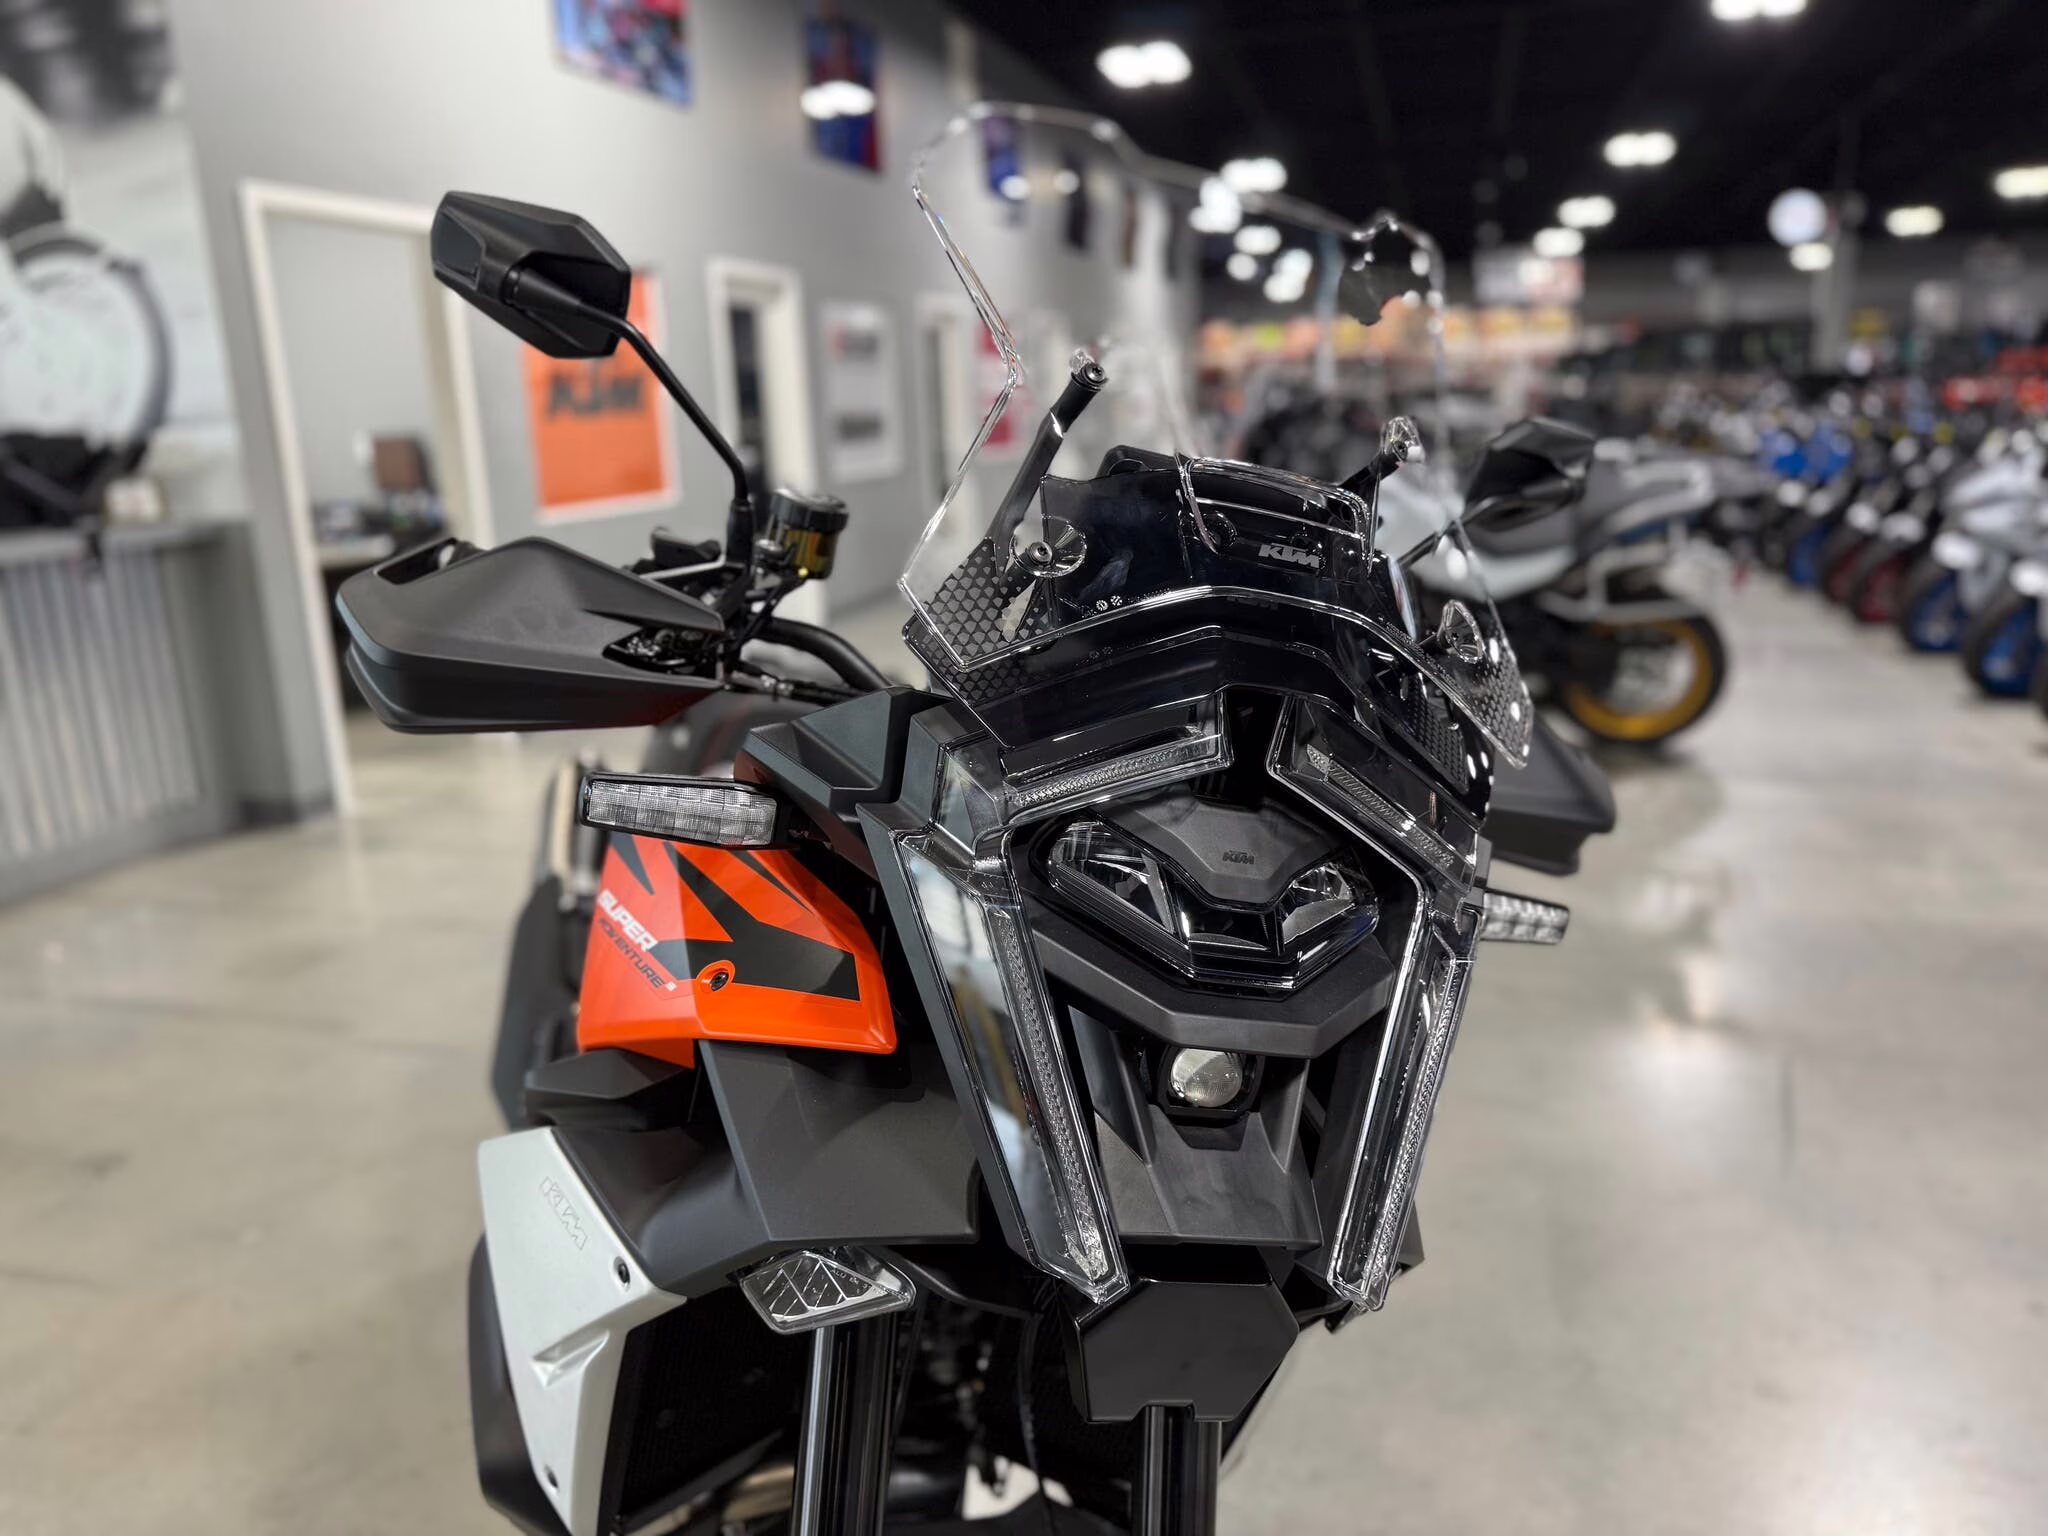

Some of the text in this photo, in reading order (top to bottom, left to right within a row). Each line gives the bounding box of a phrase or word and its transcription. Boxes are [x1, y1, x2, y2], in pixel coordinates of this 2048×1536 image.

[1258, 543, 1320, 569] KTM
[1222, 850, 1255, 864] KTM
[599, 889, 658, 951] SUPER
[540, 1175, 588, 1250] KTM
